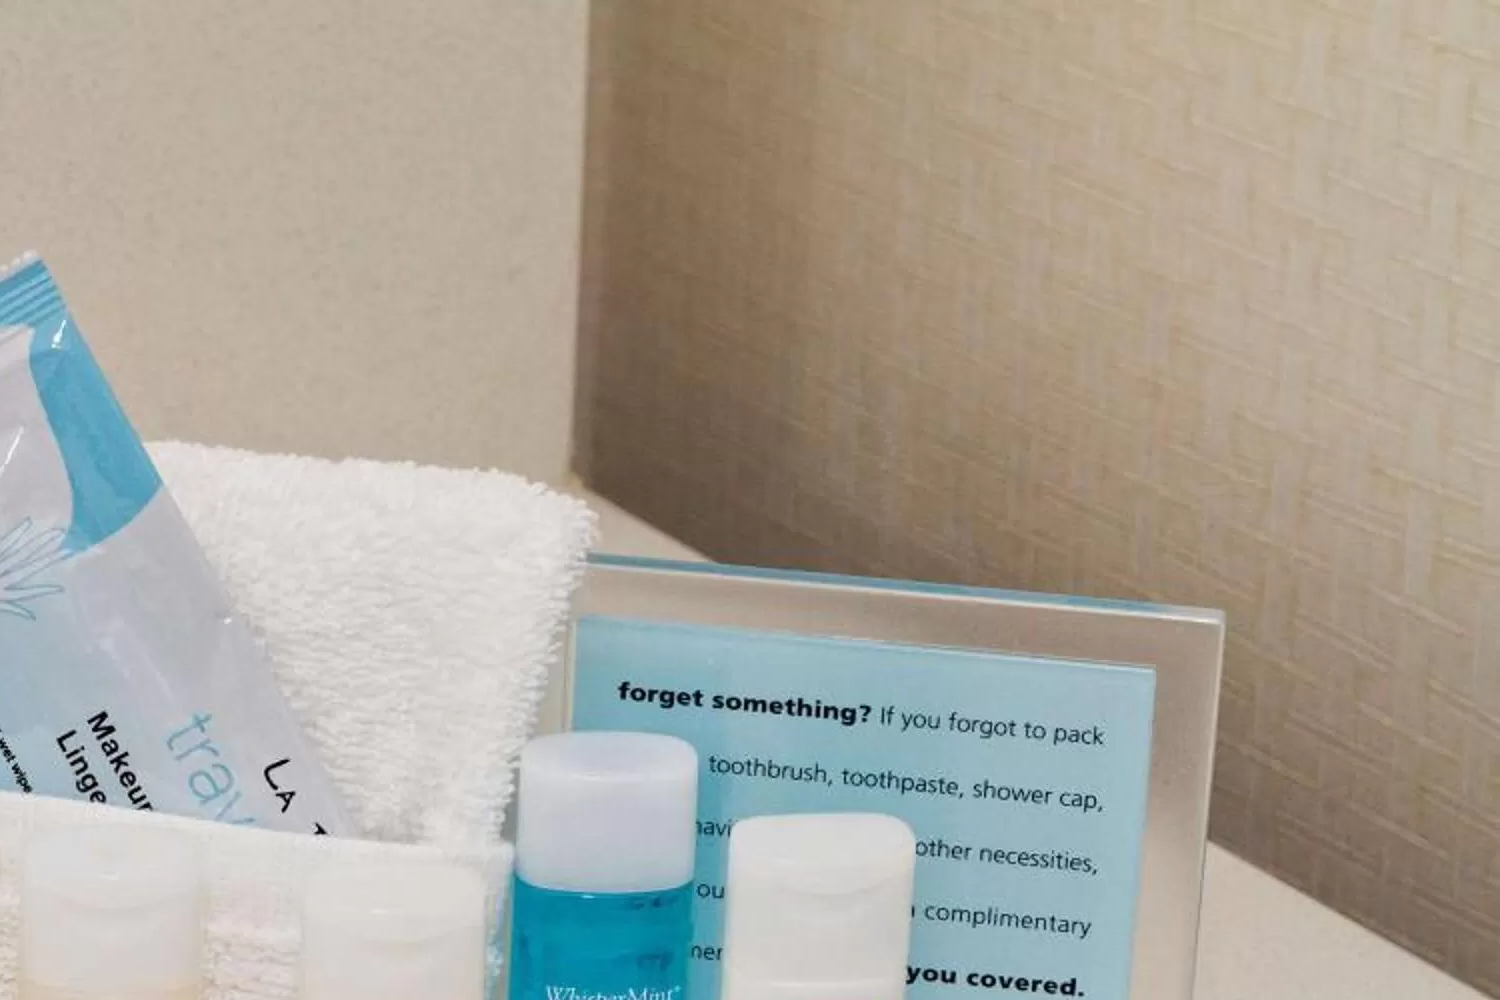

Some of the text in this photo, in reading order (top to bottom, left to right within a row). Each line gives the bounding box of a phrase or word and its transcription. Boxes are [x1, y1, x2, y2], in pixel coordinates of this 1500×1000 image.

[618, 681, 1104, 748] forget something? If you forgot to pack
[56, 729, 107, 804] Linge
[708, 754, 1104, 813] toothbrush, toothpaste, shower cap,
[915, 840, 1099, 876] other necessities,
[924, 902, 1092, 939] complimentary
[906, 964, 1085, 997] you covered.
